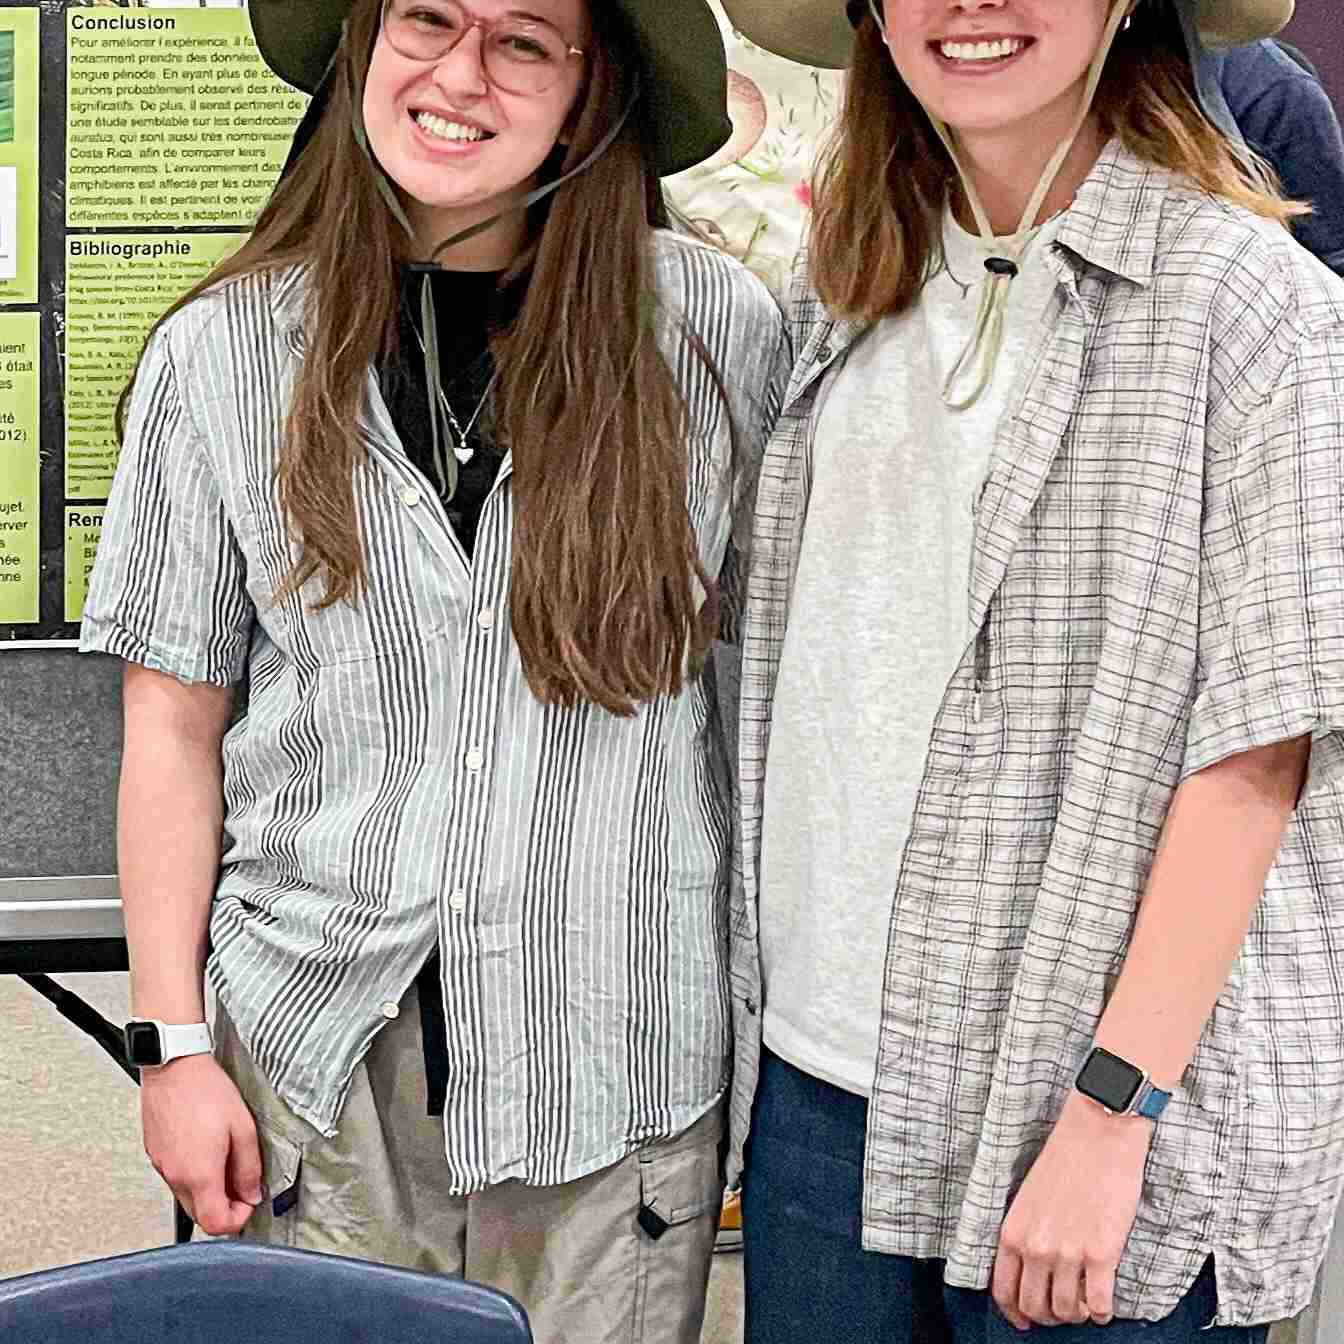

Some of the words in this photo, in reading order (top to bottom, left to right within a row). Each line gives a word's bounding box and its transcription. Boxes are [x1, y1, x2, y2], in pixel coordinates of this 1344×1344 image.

[71, 14, 176, 31] Conclusion
[70, 240, 191, 257] Bibliographie
[6, 360, 33, 373] était
